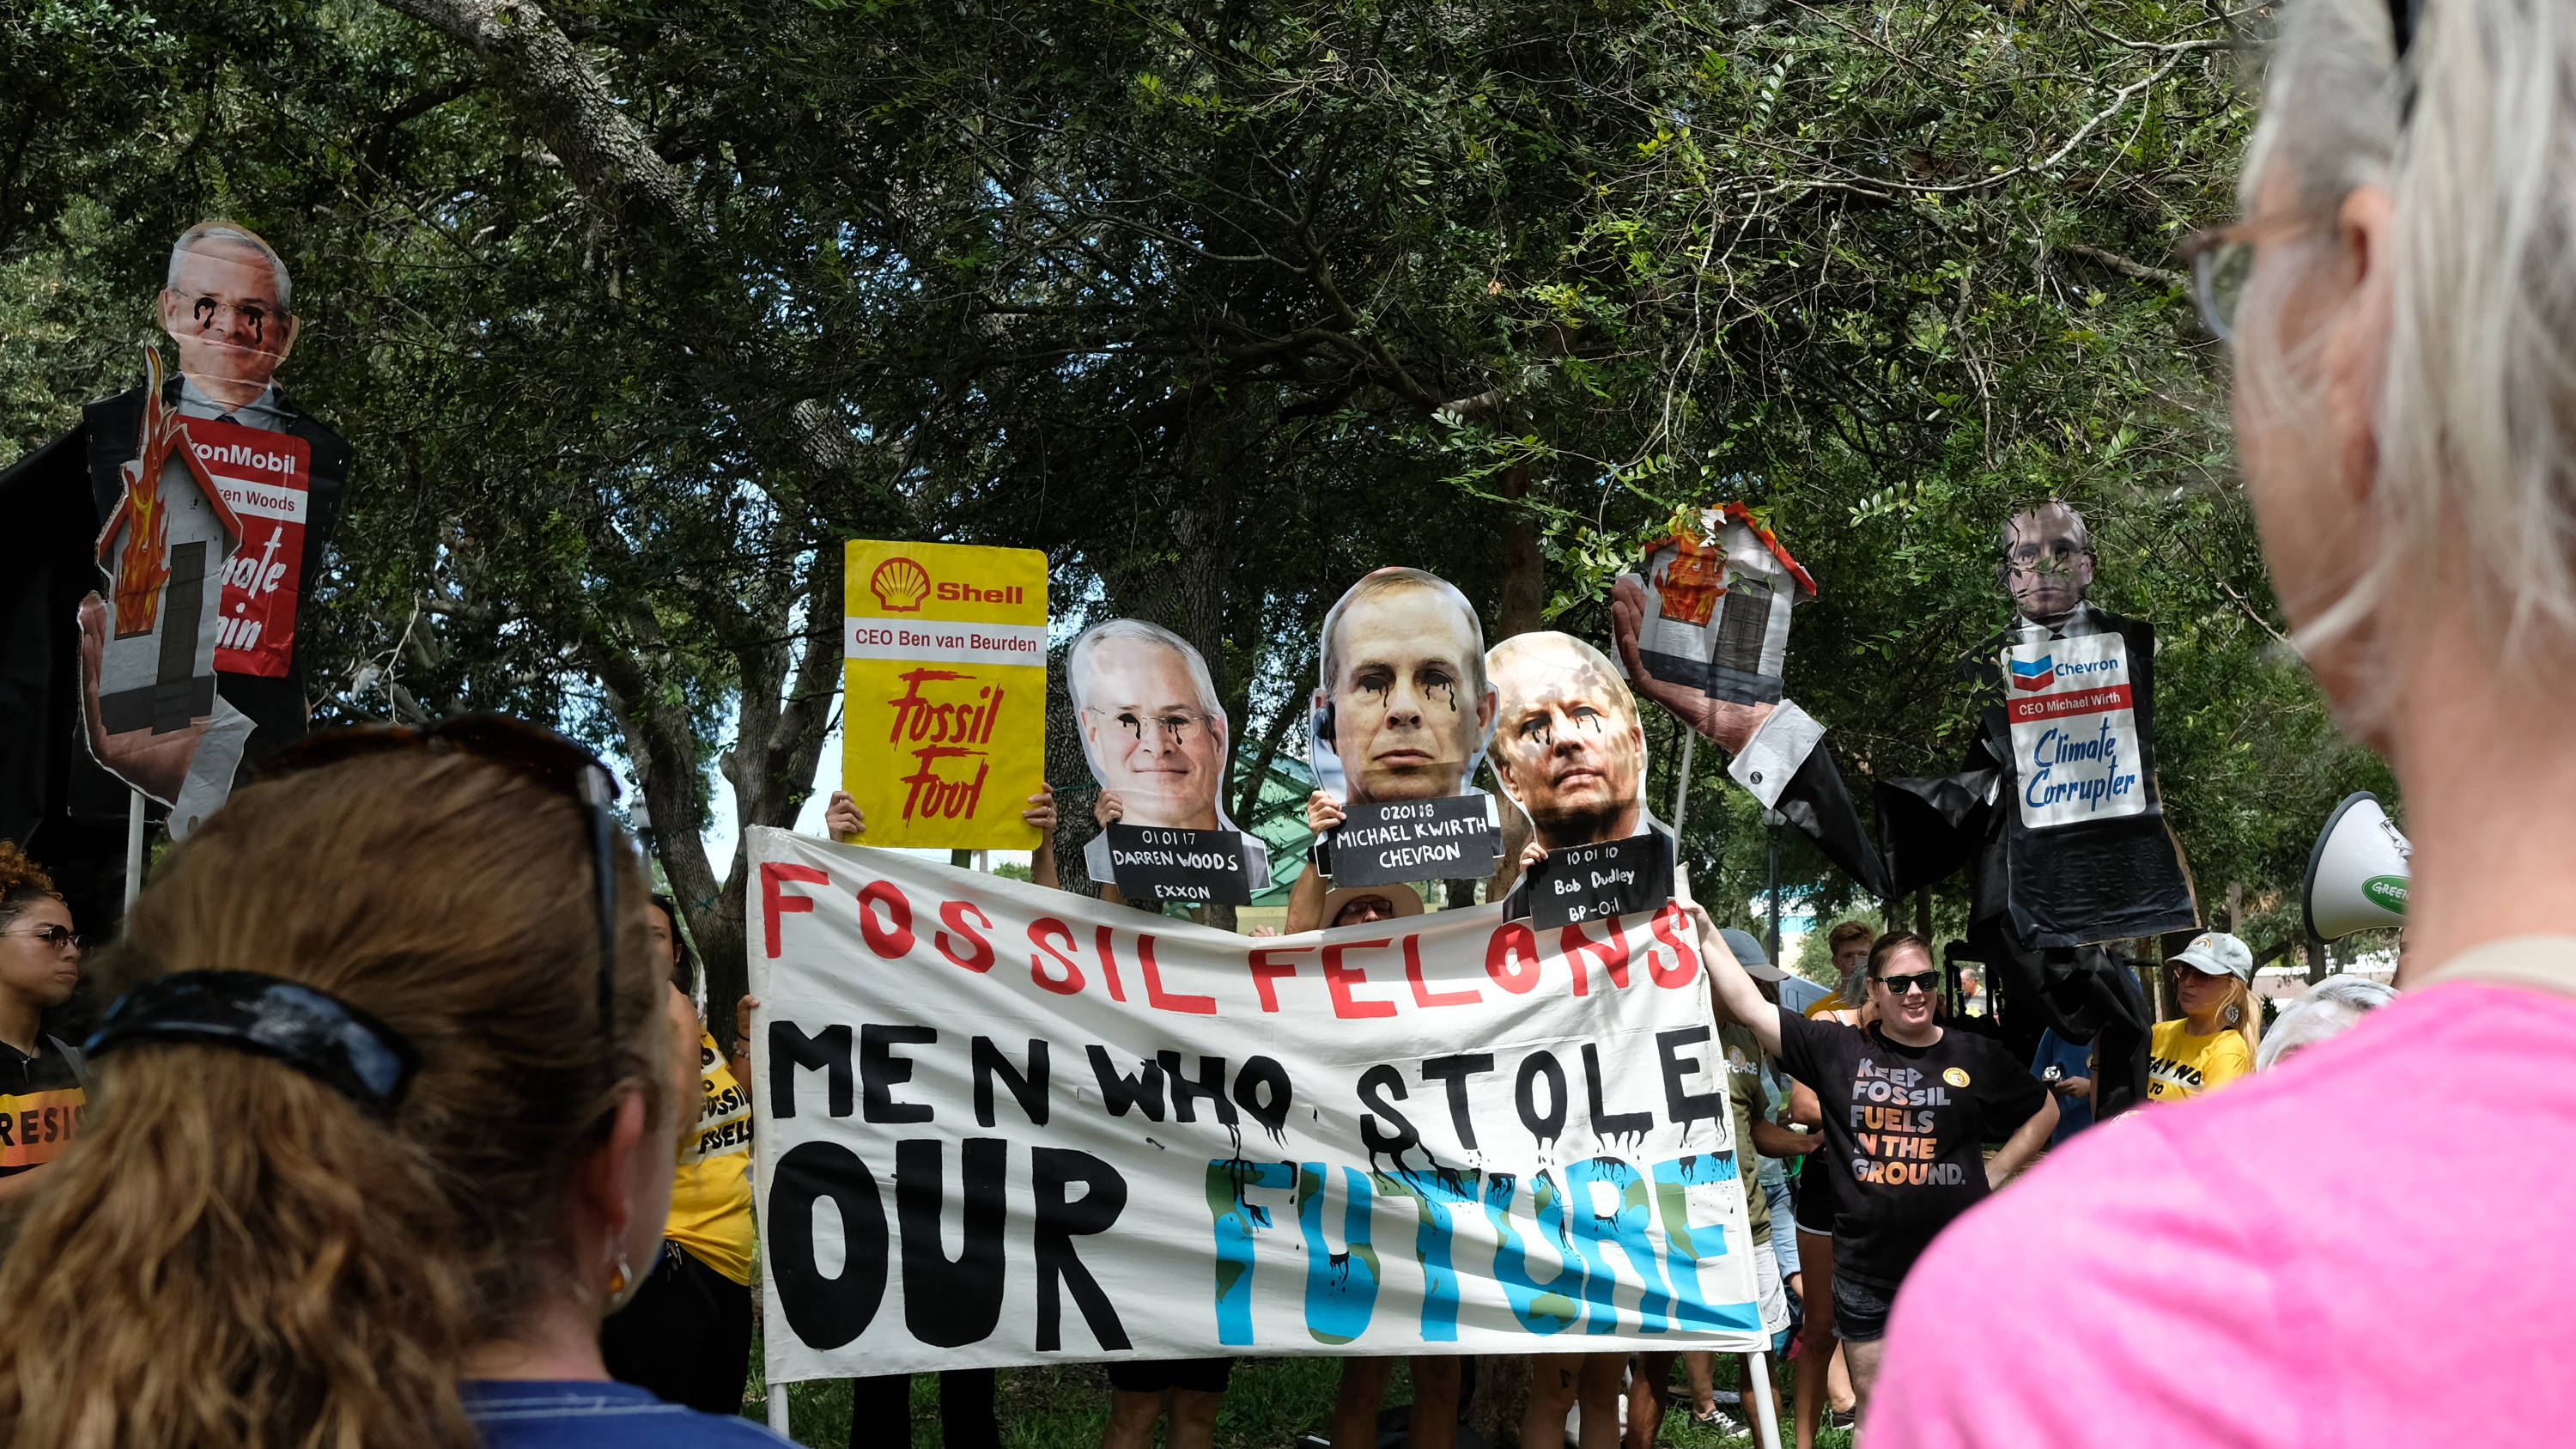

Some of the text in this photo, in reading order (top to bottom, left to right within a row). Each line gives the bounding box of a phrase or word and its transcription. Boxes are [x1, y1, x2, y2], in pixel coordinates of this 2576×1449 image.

[246, 490, 295, 512] Woods
[936, 581, 1024, 605] Shell
[855, 628, 1037, 653] CEO Ben van Beurden
[2055, 658, 2119, 677] Chevron
[888, 667, 1005, 752] Fossil
[2019, 691, 2121, 715] CEO Michael Wirth
[2033, 716, 2117, 768] Climate
[900, 744, 989, 828] Fool
[2026, 755, 2136, 812] Corrupter
[1336, 824, 1412, 849] MICHAEL
[1112, 849, 1239, 872] DARREN WOODS
[1379, 841, 1461, 869] CHEVRON
[1154, 884, 1212, 899] EXXON
[1553, 868, 1636, 895] Bob Dudley
[759, 861, 1699, 1020] FOSSIL FELONS
[1856, 1057, 1924, 1088] KEEP
[769, 1020, 1725, 1160] MEN WHO STOLE
[1852, 1080, 1952, 1106] FOSSIL
[2148, 1082, 2165, 1095] TO
[1850, 1105, 1935, 1134] FUELS
[1881, 1135, 1938, 1160] THE
[1851, 1158, 1967, 1186] GROUND.
[767, 1137, 1763, 1352] OUR FUTURE
